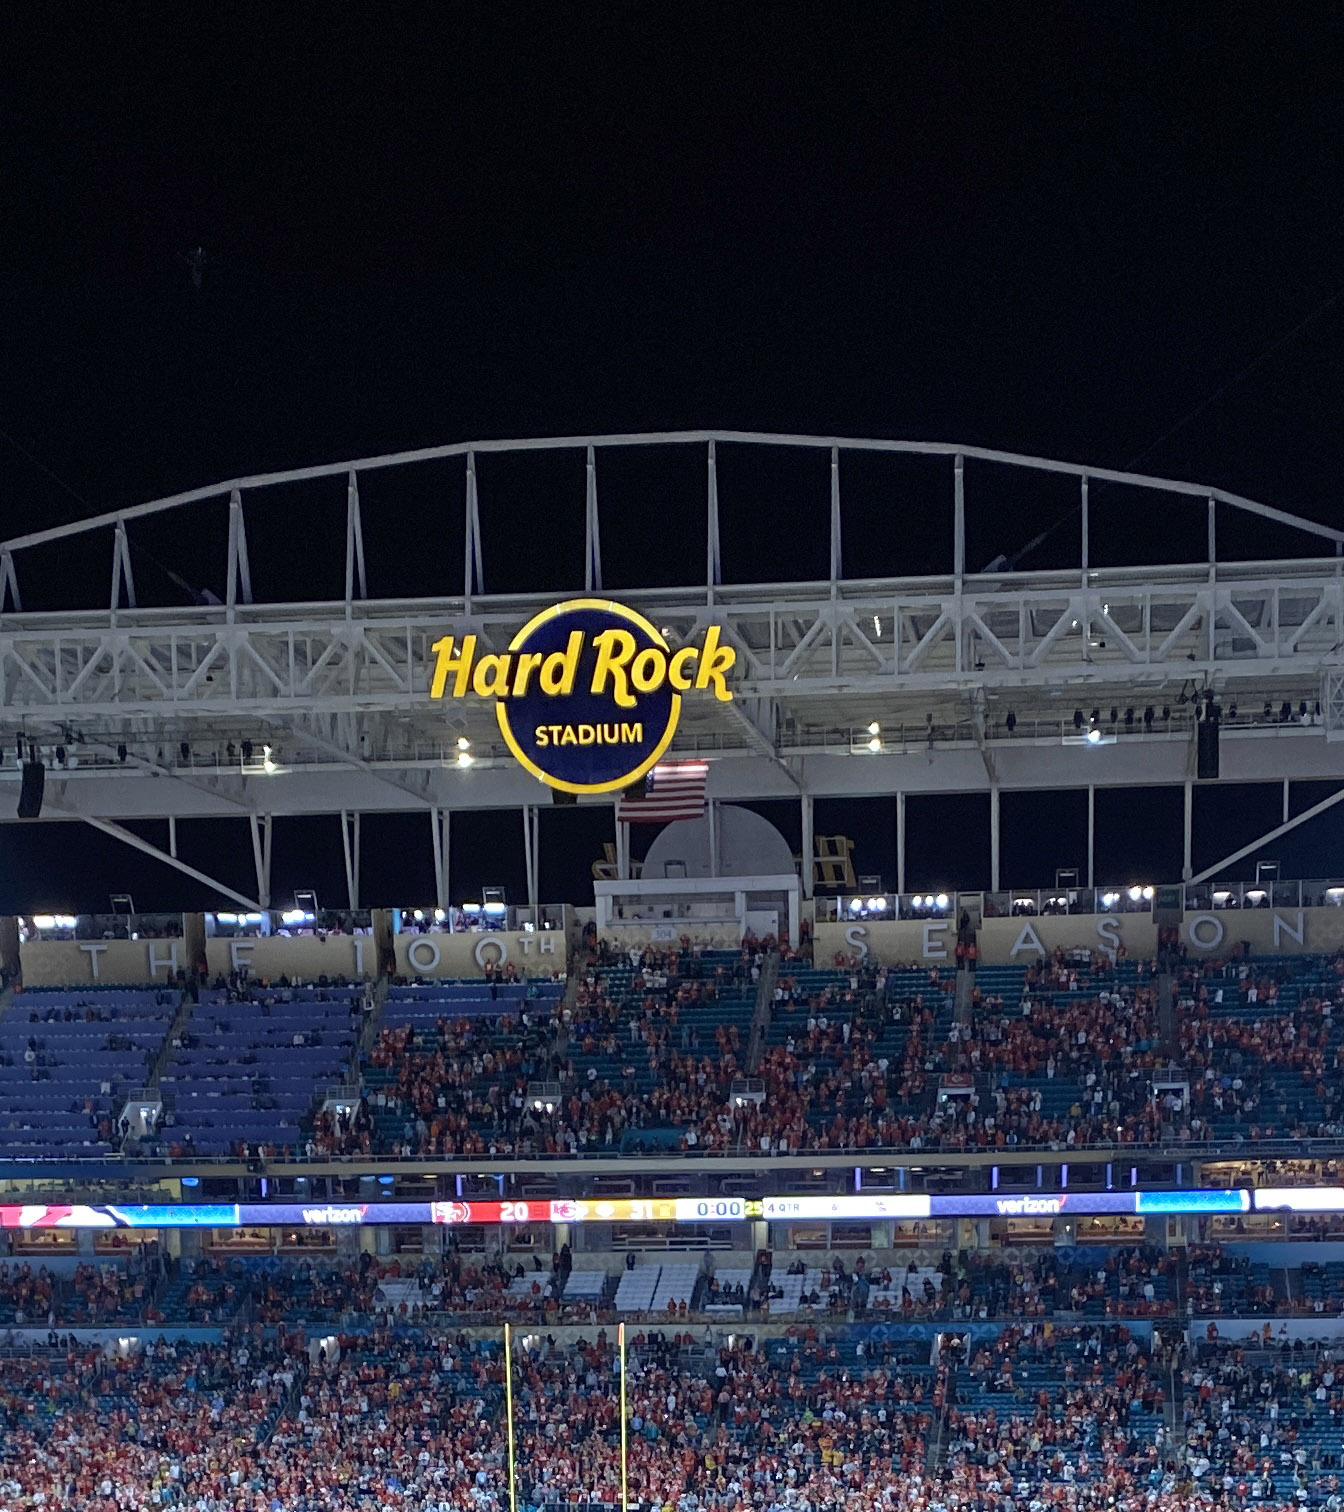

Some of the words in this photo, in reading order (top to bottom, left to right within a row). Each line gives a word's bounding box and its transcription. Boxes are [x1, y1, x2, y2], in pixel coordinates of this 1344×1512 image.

[429, 630, 583, 699] Hard
[591, 625, 736, 708] Rock
[535, 722, 644, 747] STADIUM
[80, 941, 256, 978] THE
[500, 1202, 529, 1221] 20
[697, 1202, 741, 1216] 0:00
[778, 1203, 800, 1212] QTR
[997, 1196, 1060, 1213] verizon
[303, 1206, 362, 1223] verizon
